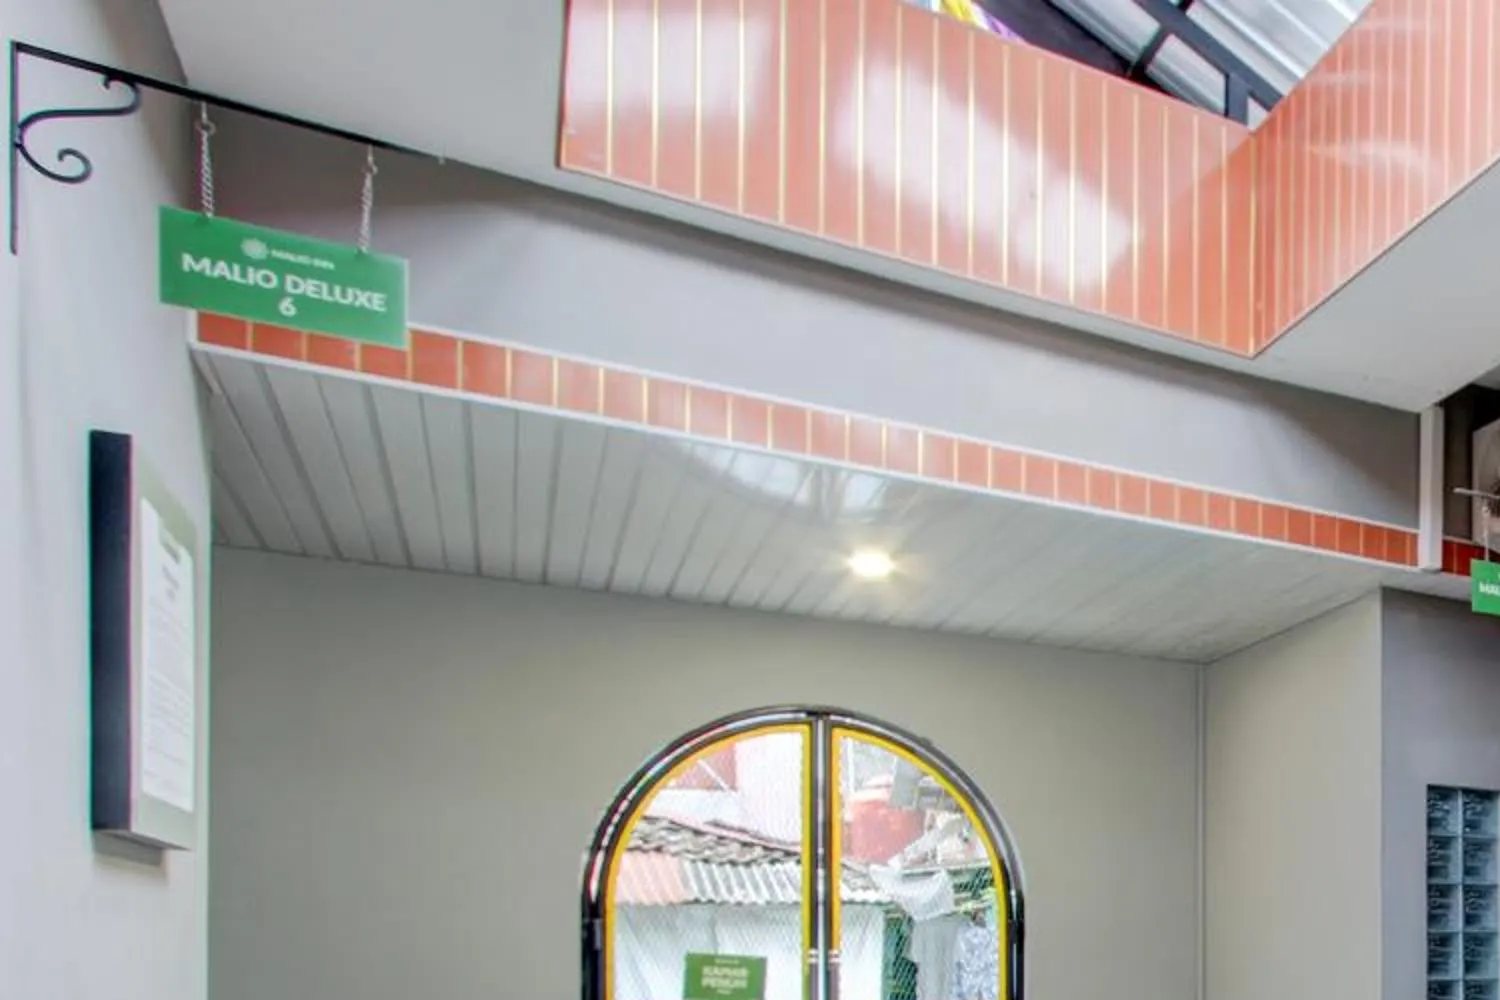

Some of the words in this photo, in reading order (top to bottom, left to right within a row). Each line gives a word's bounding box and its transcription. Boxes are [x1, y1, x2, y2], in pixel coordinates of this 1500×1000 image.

[181, 252, 278, 289] MALIO
[284, 274, 387, 312] DELUXE
[278, 298, 297, 317] 6
